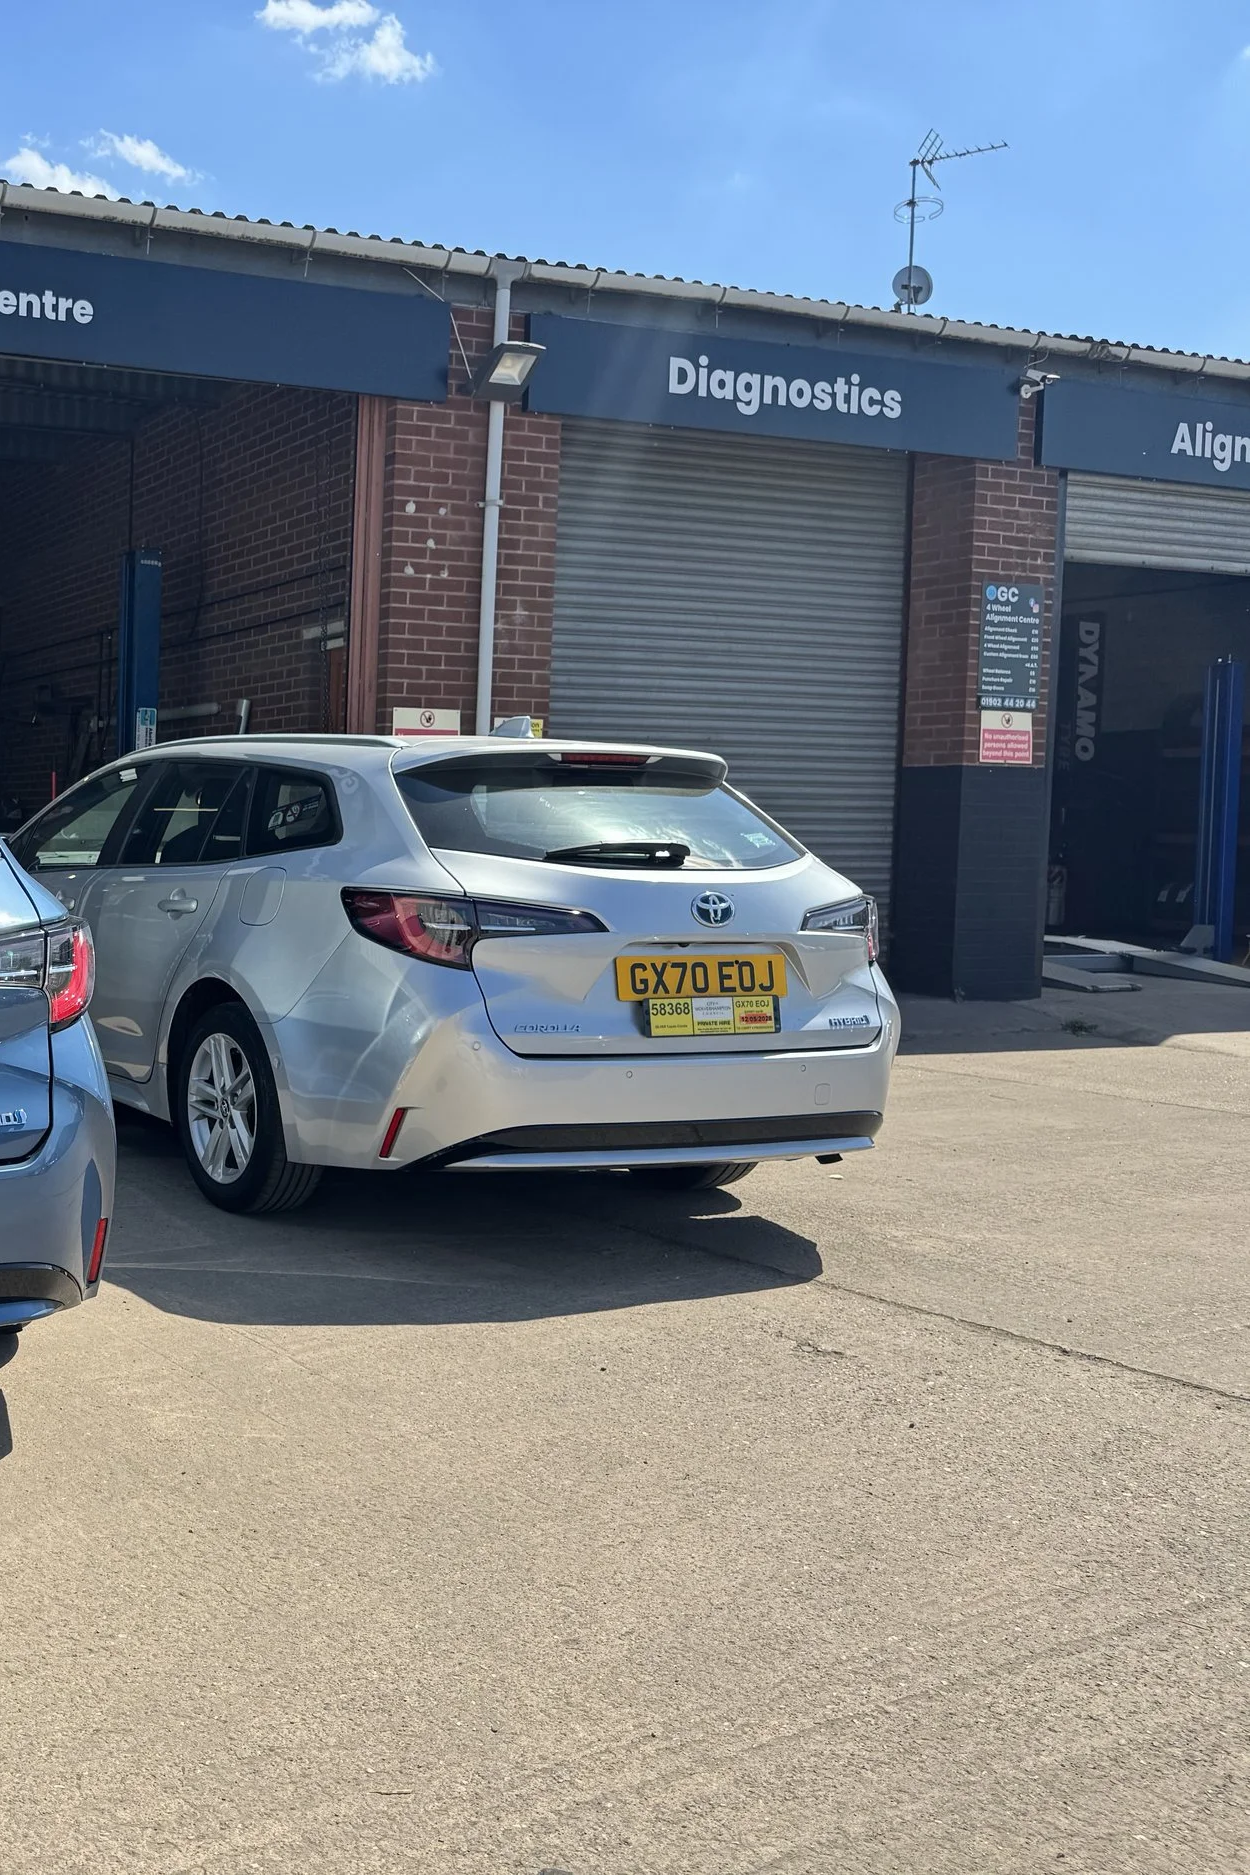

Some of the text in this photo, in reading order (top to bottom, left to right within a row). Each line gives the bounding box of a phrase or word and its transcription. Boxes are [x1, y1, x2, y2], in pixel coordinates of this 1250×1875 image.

[668, 355, 902, 419] Diagnostics
[997, 586, 1019, 602] GC
[992, 604, 1011, 612] Wheel
[985, 613, 1039, 624] Alignment Centre
[1075, 621, 1100, 762] DYNAMO
[981, 697, 1036, 709] 01902 44 20 44
[630, 960, 775, 995] GX70 EOJ
[651, 1002, 690, 1017] 58368
[735, 999, 770, 1008] GX70 EOJ
